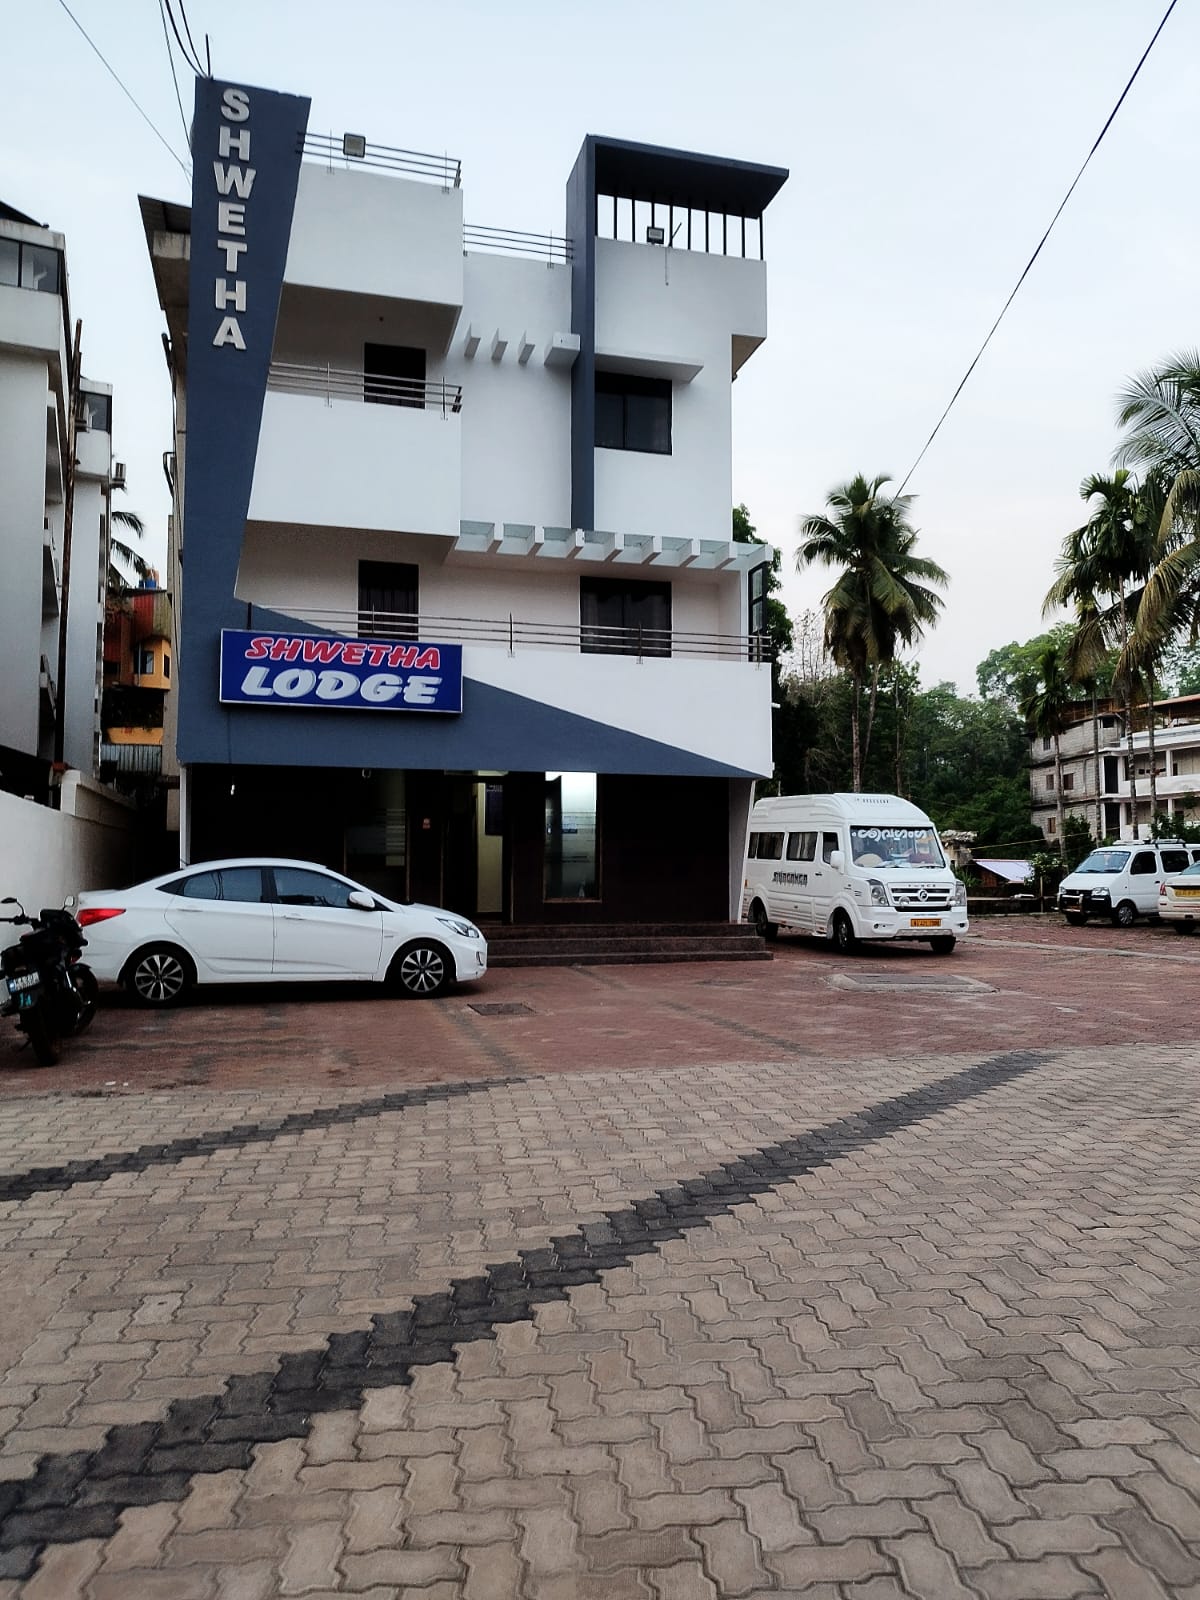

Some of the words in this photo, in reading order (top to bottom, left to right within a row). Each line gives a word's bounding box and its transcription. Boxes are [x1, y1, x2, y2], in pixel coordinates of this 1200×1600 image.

[212, 88, 256, 350] SHWETHA
[245, 636, 440, 670] SHWETHA
[241, 666, 442, 704] LODGE
